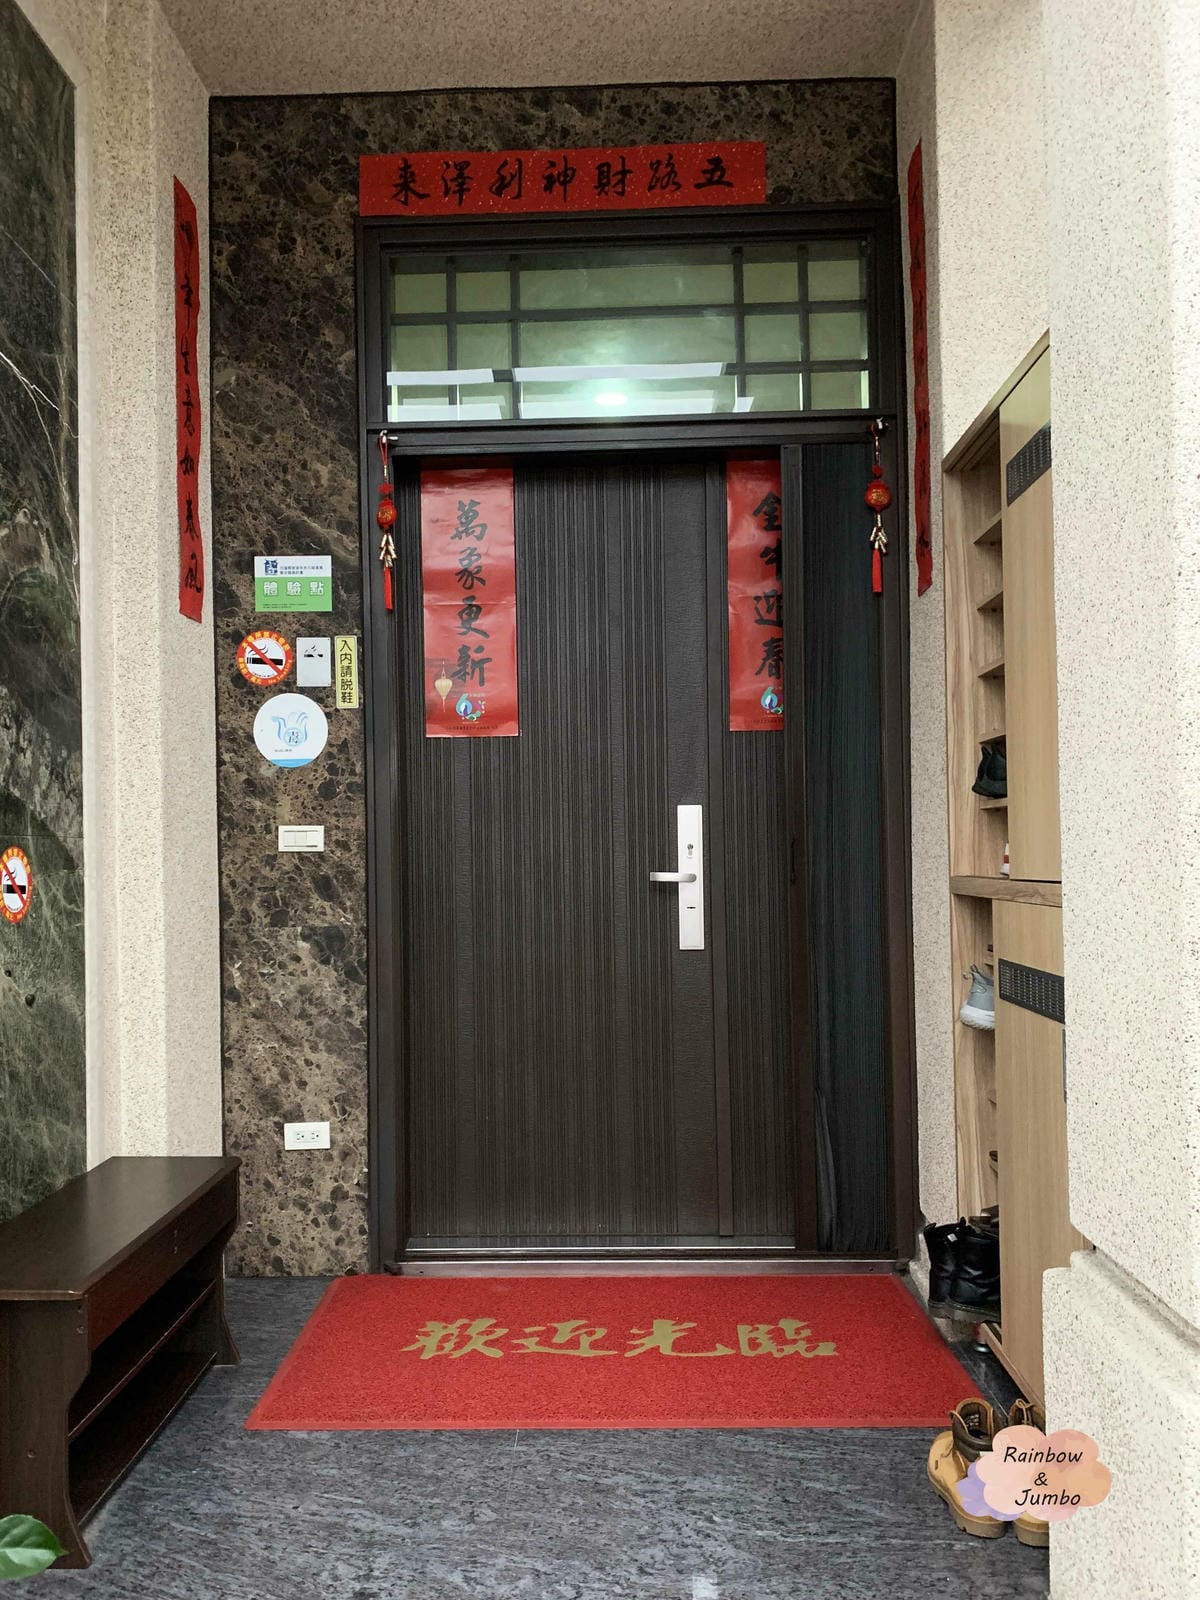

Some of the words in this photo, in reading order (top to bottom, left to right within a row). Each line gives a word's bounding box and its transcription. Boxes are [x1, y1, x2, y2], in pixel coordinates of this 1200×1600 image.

[263, 581, 324, 596] 體驗點
[449, 498, 493, 688] 萬象更新
[400, 1316, 838, 1360] 歡迎光臨
